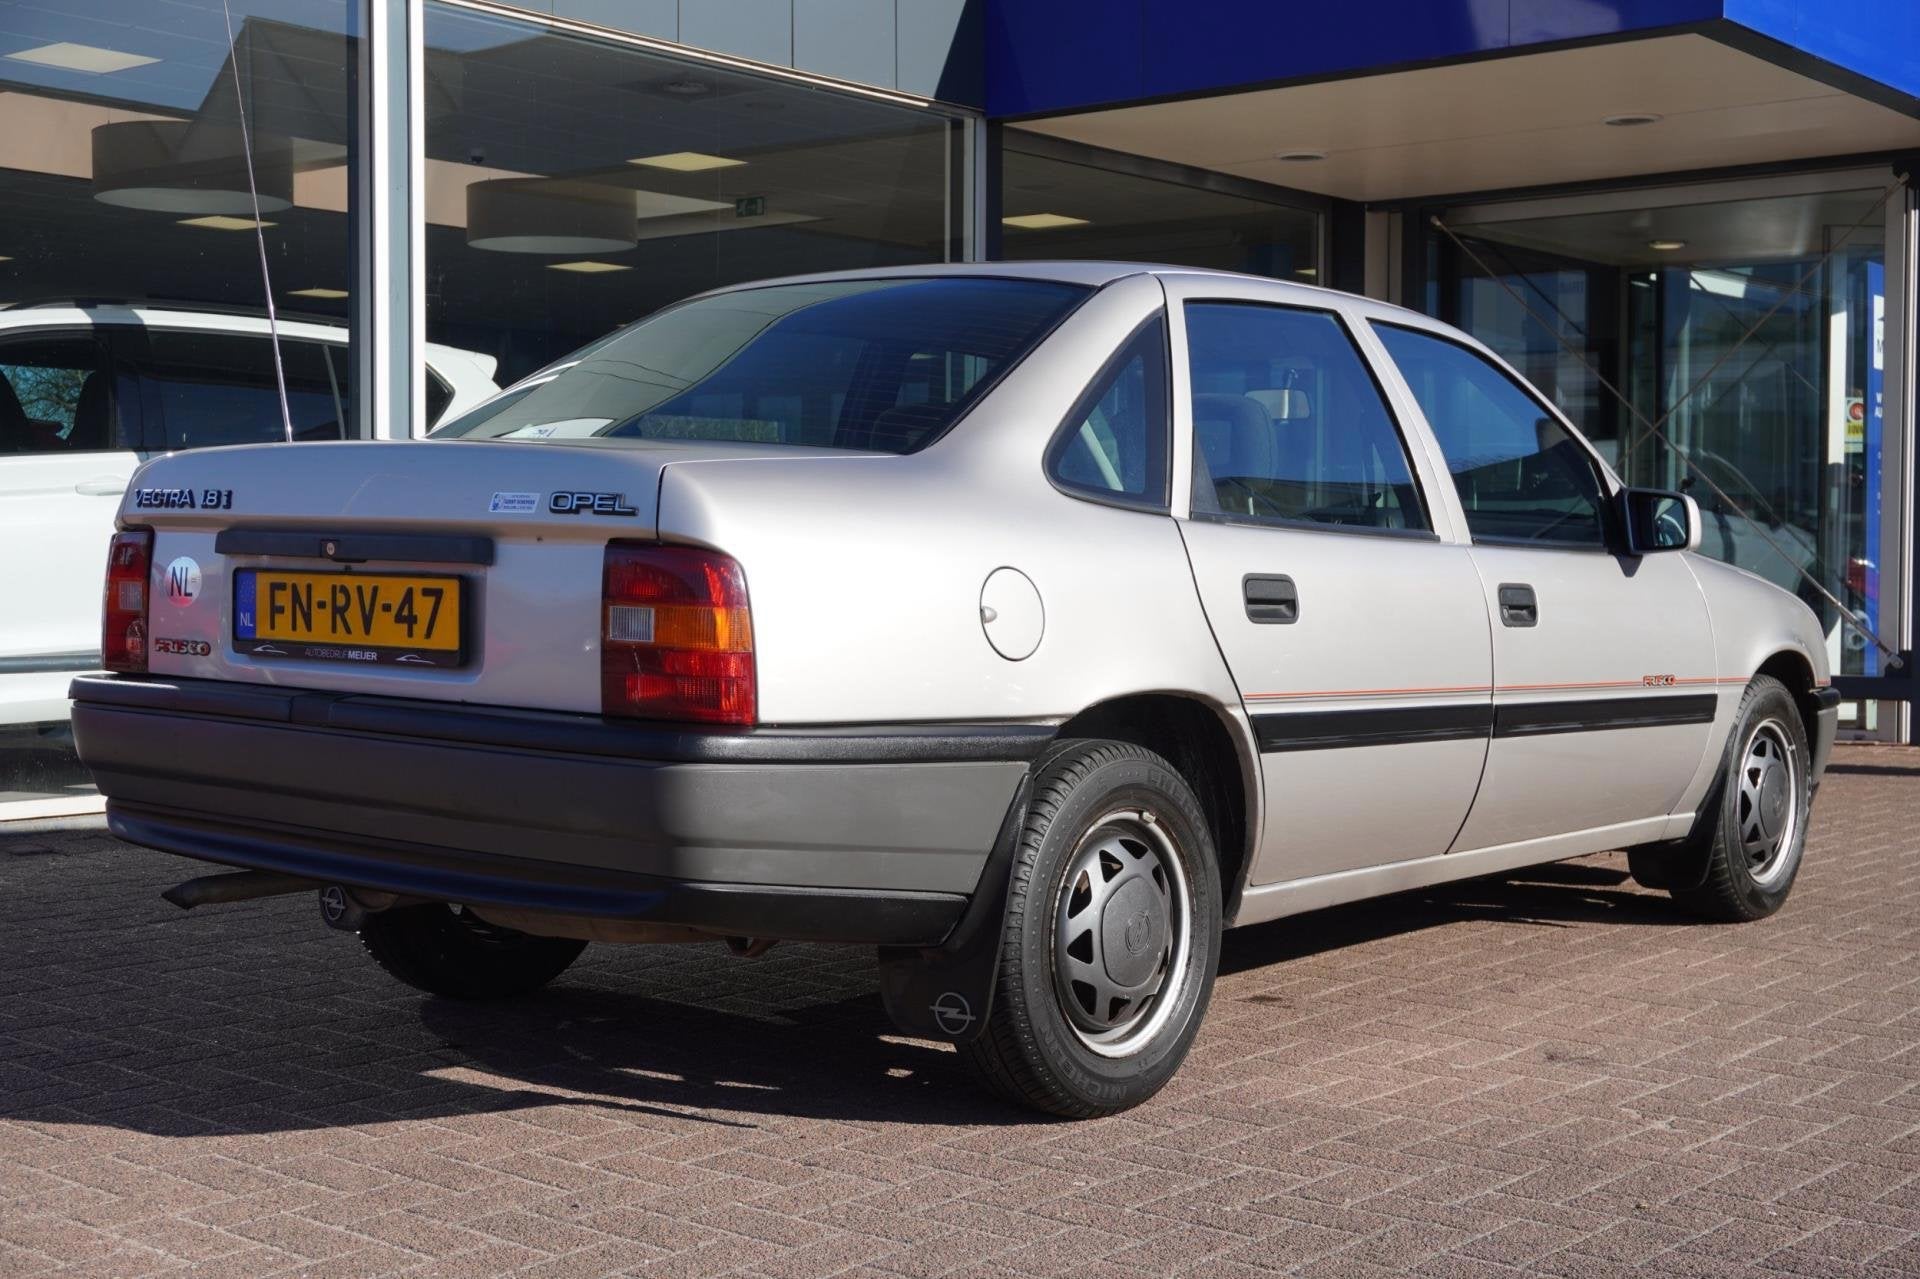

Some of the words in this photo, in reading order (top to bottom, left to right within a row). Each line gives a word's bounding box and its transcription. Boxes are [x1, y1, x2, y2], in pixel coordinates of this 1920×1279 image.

[135, 488, 195, 508] VECTRA
[549, 491, 639, 516] OPEL
[170, 566, 193, 597] NL
[240, 612, 253, 627] NL
[269, 582, 444, 640] FN-RV-47
[155, 637, 211, 656] FRISCO
